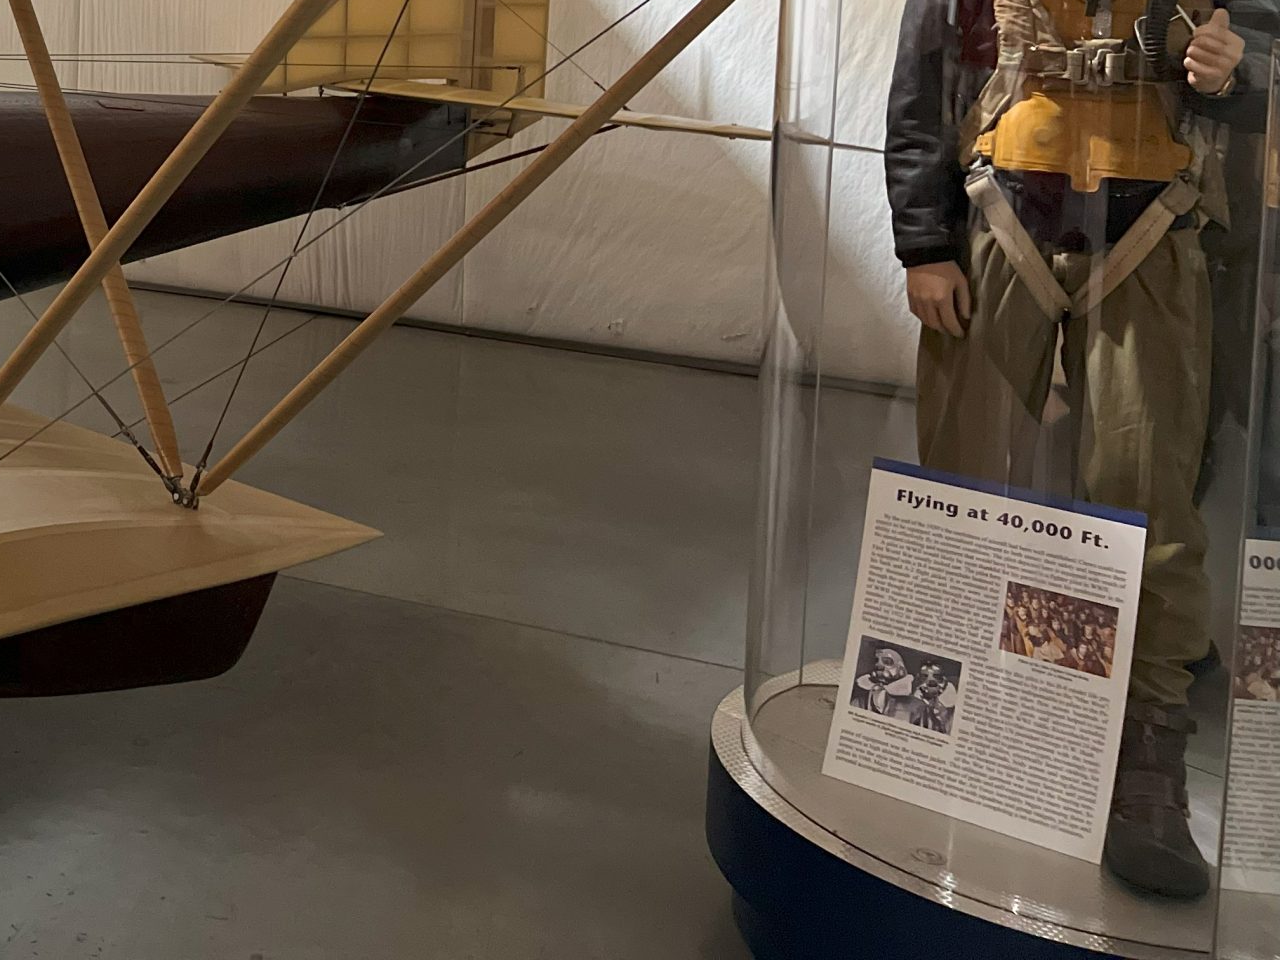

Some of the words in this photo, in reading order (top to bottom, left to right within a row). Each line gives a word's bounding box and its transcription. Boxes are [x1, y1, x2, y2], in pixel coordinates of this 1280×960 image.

[896, 488, 959, 518] Flying
[967, 507, 989, 522] at
[996, 512, 1073, 540] 40,000
[1081, 530, 1110, 550] Ft.
